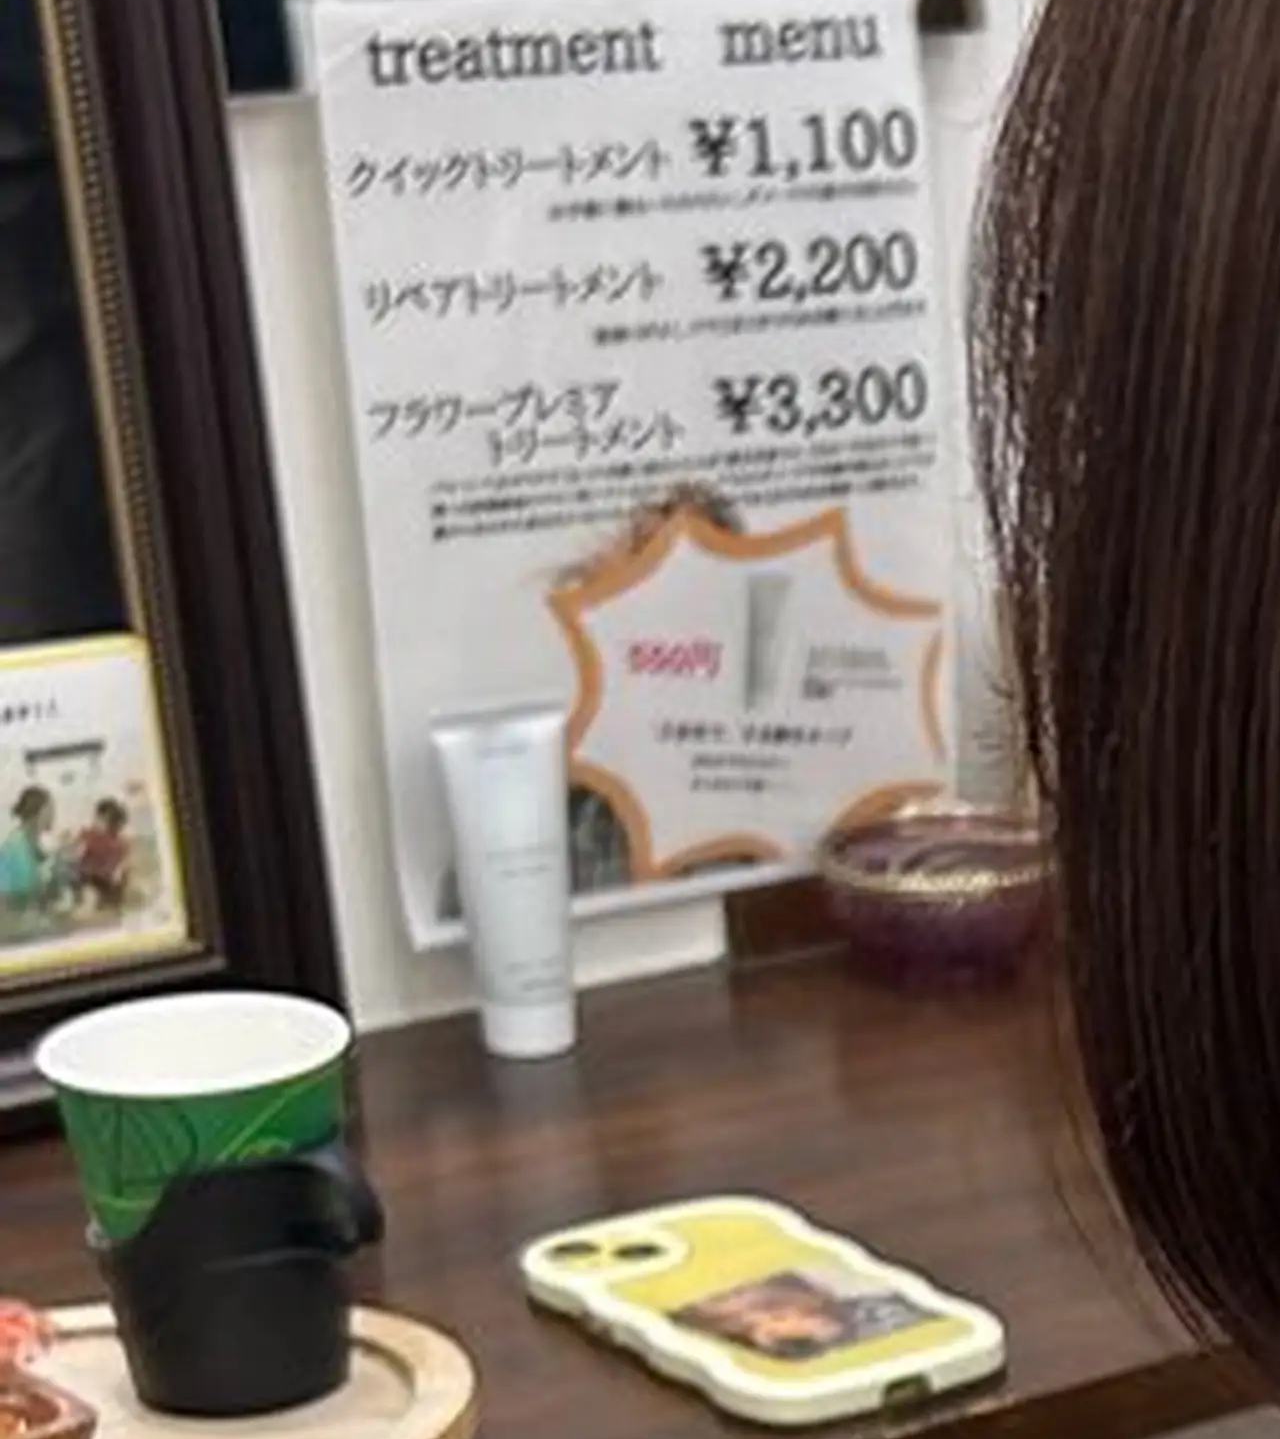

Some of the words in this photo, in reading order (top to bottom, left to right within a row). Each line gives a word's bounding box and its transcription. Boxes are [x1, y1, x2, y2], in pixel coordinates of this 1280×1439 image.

[365, 21, 664, 87] treatment
[718, 11, 882, 68] menu
[346, 138, 671, 199] クイックトリートメント
[690, 107, 920, 182] ¥1,100
[364, 263, 664, 324] リペアトリートメント
[702, 231, 920, 303] ¥2,200
[366, 380, 622, 439] フラワープレミア
[713, 363, 928, 437] ¥3,300
[487, 409, 686, 464] トリートメント
